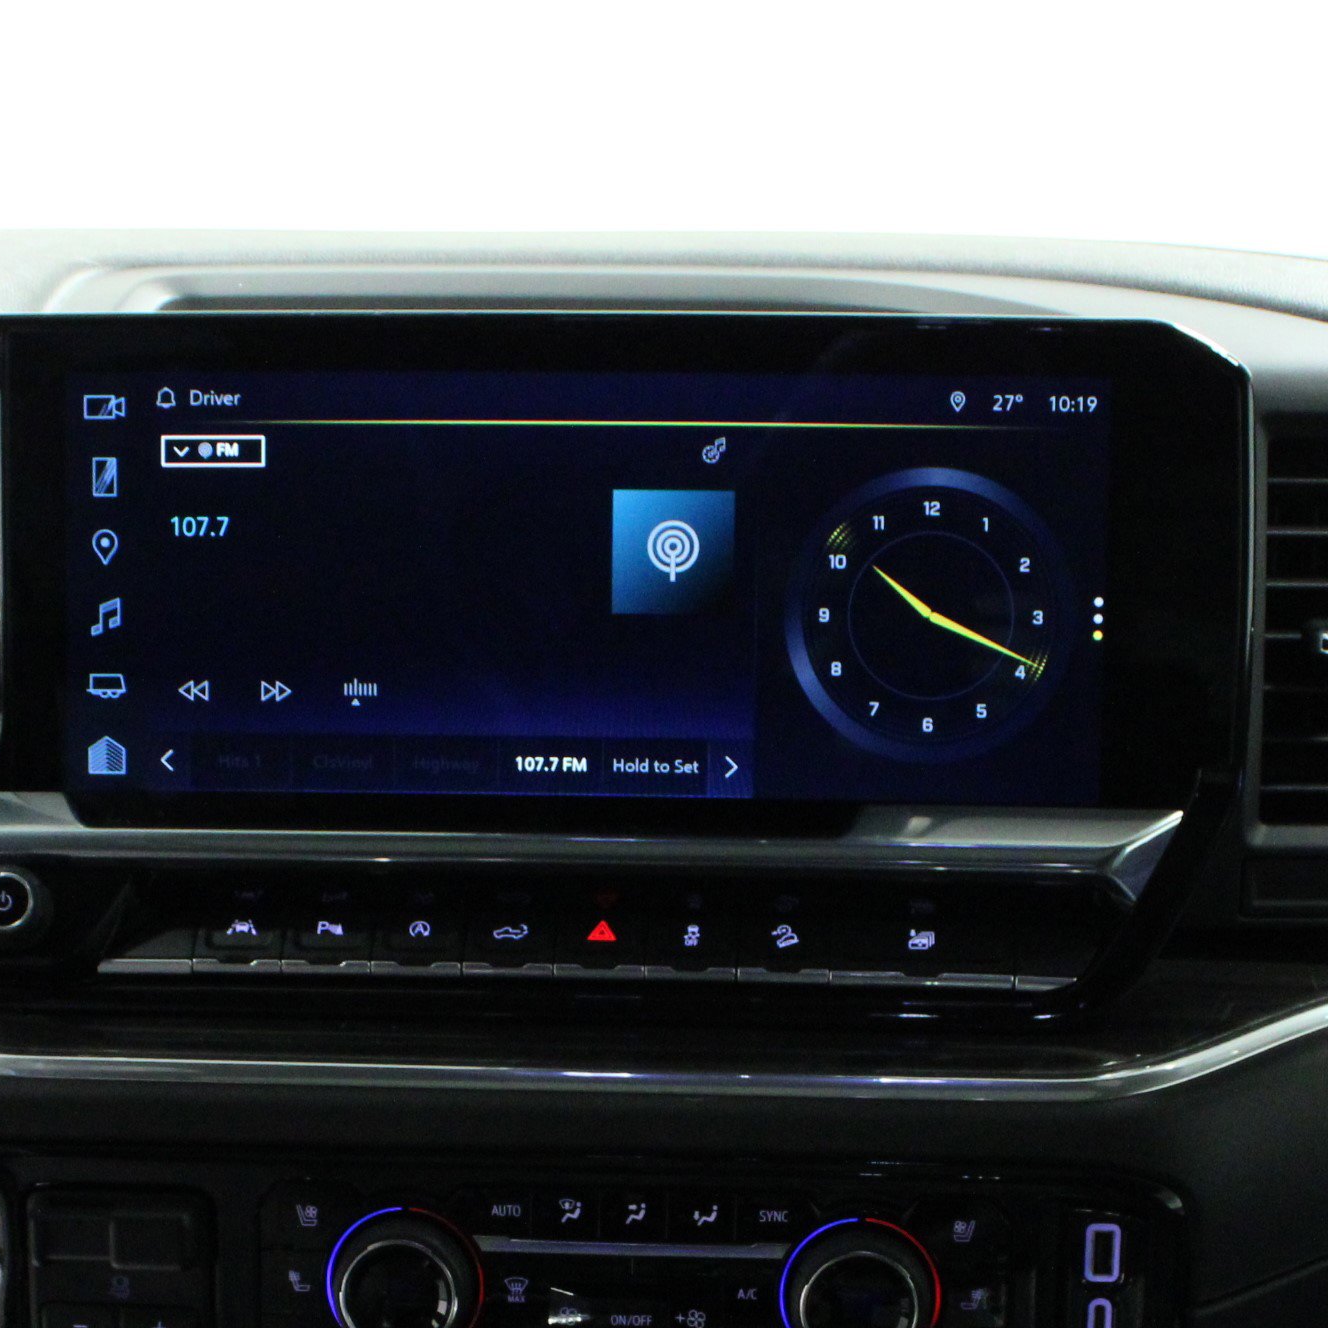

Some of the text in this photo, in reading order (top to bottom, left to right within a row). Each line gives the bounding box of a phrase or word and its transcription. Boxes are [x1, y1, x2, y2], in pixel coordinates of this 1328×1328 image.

[189, 389, 241, 407] Driver
[1048, 396, 1098, 413] 10:19
[215, 442, 240, 457] FM
[923, 501, 941, 516] 12
[170, 516, 230, 537] 107.7
[872, 515, 885, 530] 11
[982, 517, 989, 532] 1
[828, 554, 847, 569] 10
[1019, 558, 1031, 573] 2
[818, 608, 830, 623] 9
[1032, 610, 1044, 625] 3
[830, 661, 842, 677] 8
[1014, 665, 1026, 680] 4
[869, 702, 880, 717] 7
[976, 703, 987, 719] 5
[922, 718, 933, 733] 6
[514, 756, 587, 774] 107.7 FM
[612, 758, 700, 775] Hold to Set
[491, 1204, 521, 1217] AUTO
[759, 1210, 789, 1224] SYNC
[737, 1287, 758, 1301] A/C
[610, 1314, 653, 1327] ON/OFF
